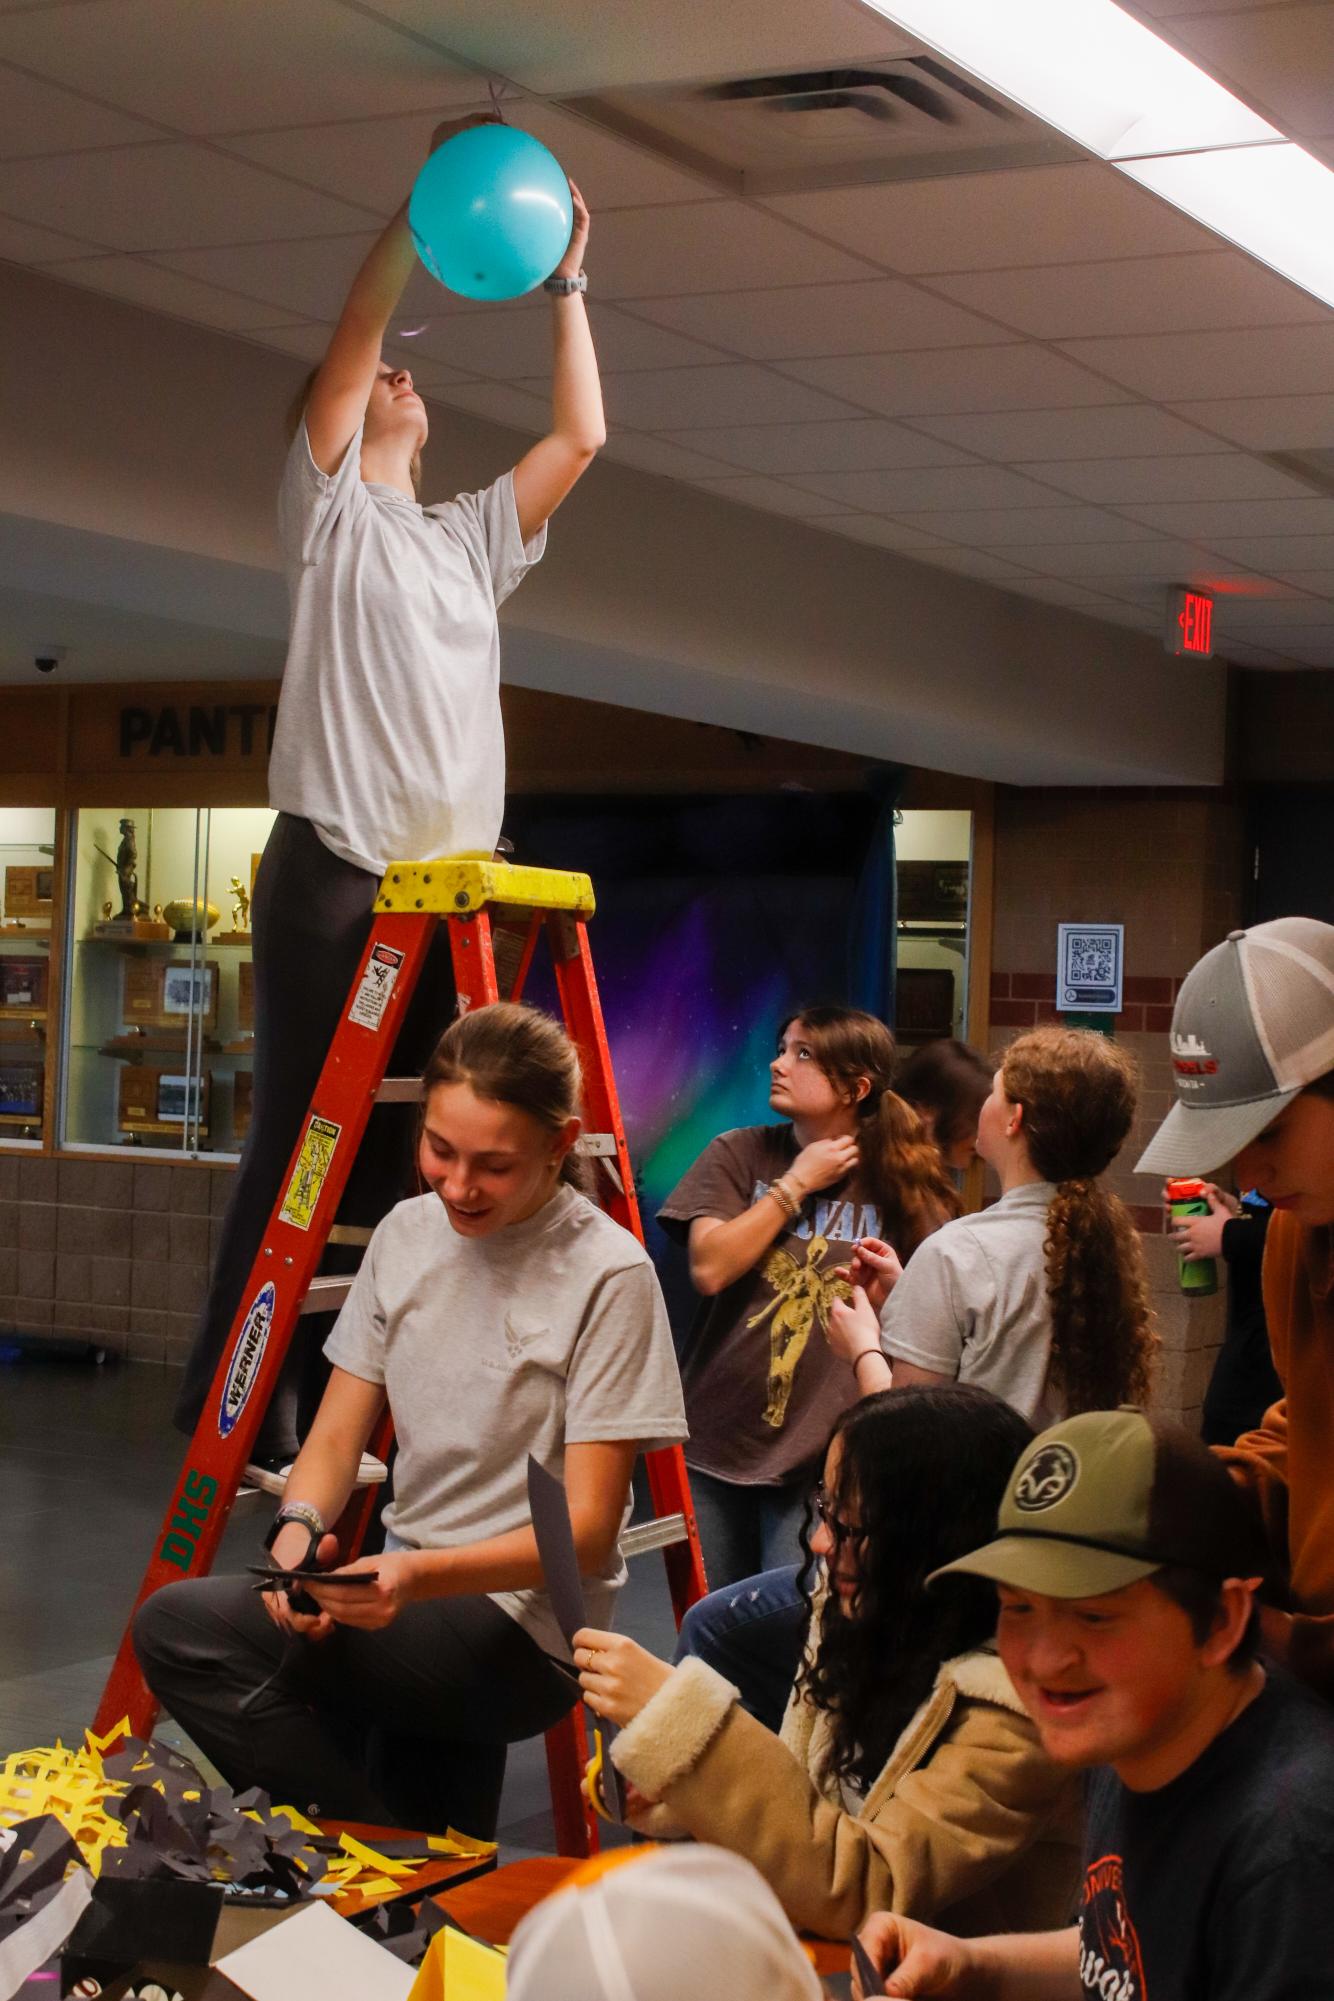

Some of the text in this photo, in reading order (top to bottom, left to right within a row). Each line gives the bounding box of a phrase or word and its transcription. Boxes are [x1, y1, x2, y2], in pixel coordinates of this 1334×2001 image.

[1184, 592, 1214, 655] EXIT
[228, 1310, 267, 1407] WERNER
[159, 1468, 219, 1573] DHS
